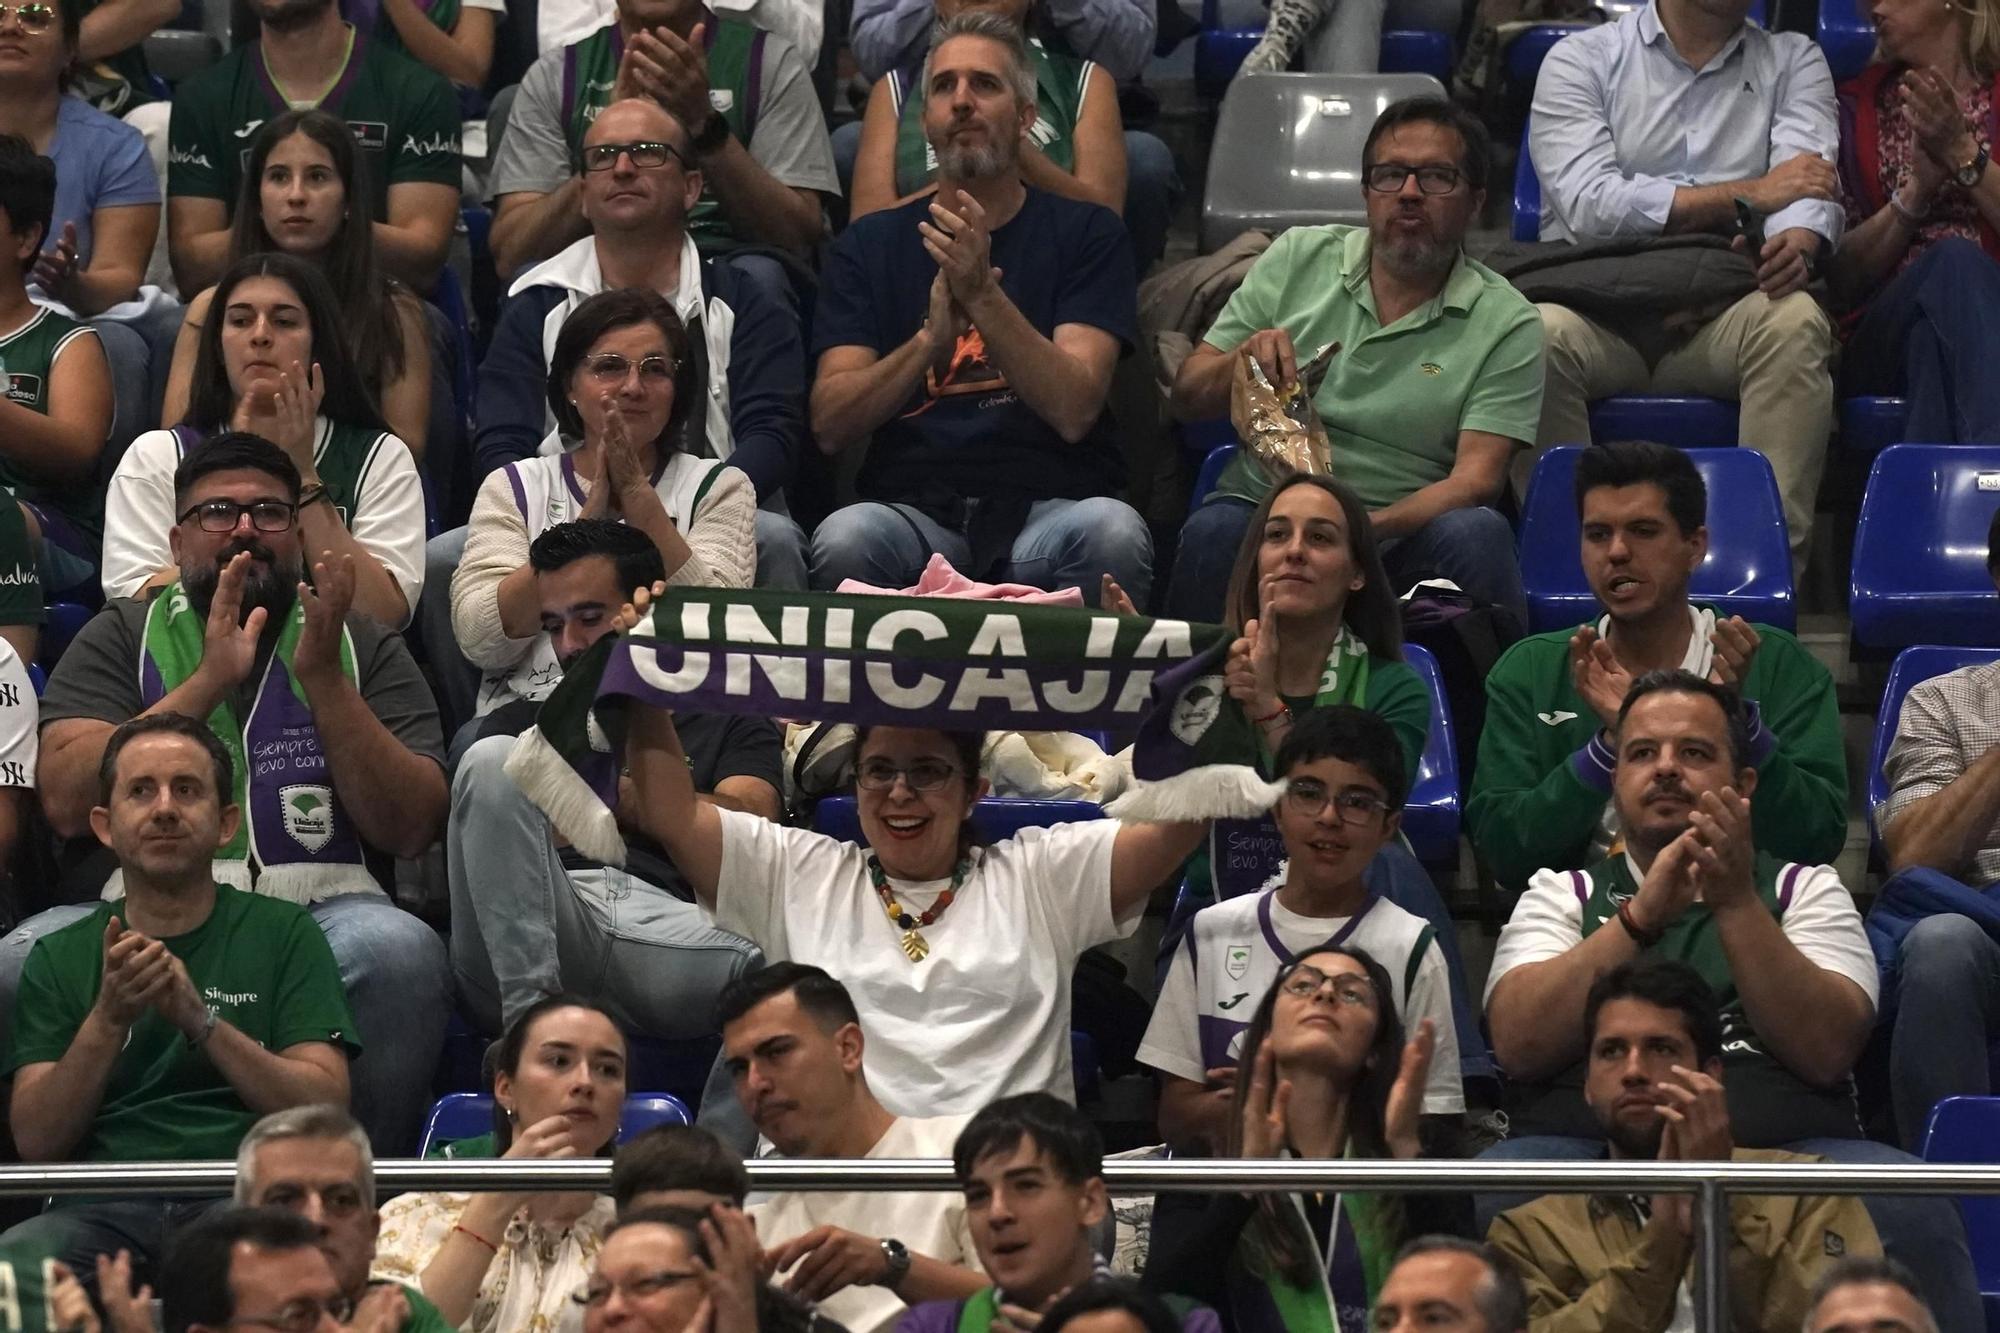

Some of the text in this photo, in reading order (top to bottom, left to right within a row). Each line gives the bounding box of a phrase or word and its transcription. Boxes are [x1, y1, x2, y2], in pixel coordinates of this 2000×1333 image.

[629, 601, 1193, 713] UNICAJA
[254, 738, 317, 759] Siempre
[205, 986, 258, 1007] Siempre
